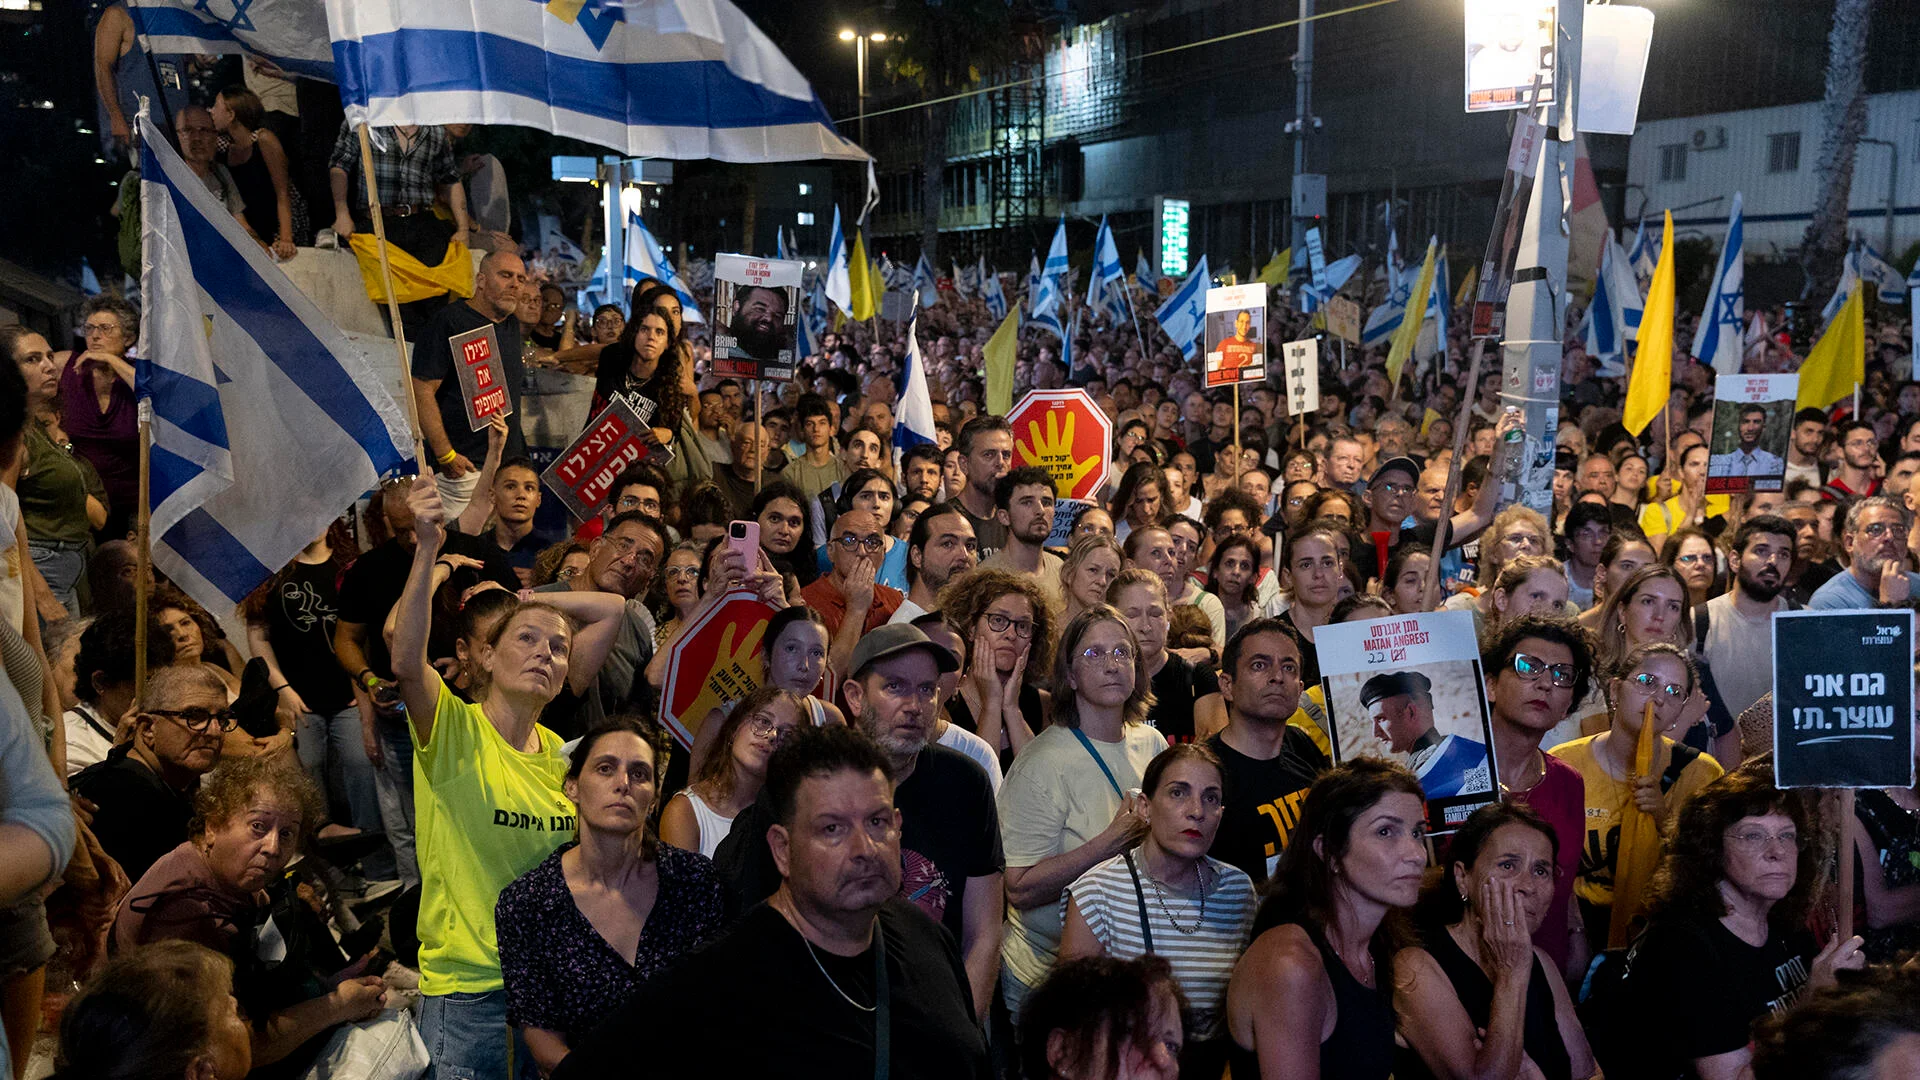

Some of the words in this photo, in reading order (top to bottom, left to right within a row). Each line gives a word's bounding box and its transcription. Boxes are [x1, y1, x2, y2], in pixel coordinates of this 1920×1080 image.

[464, 340, 490, 362] הצילו
[715, 336, 738, 348] BRING
[714, 348, 729, 359] HIM
[478, 368, 491, 385] את
[475, 390, 504, 416] החטופים
[563, 421, 619, 478] הצילו
[584, 444, 638, 501] עכשיו
[1370, 624, 1401, 638] אנגרסט
[1404, 620, 1418, 632] מתן
[1364, 636, 1392, 651] MATAN
[1394, 632, 1430, 648] ANGREST
[1368, 653, 1386, 664] 22
[716, 668, 736, 688] זועק
[732, 662, 746, 678] דמי
[1805, 674, 1844, 697] אני
[1850, 673, 1885, 696] גם
[1792, 706, 1894, 730] עוצר.ת!
[494, 810, 544, 831] איתכם
